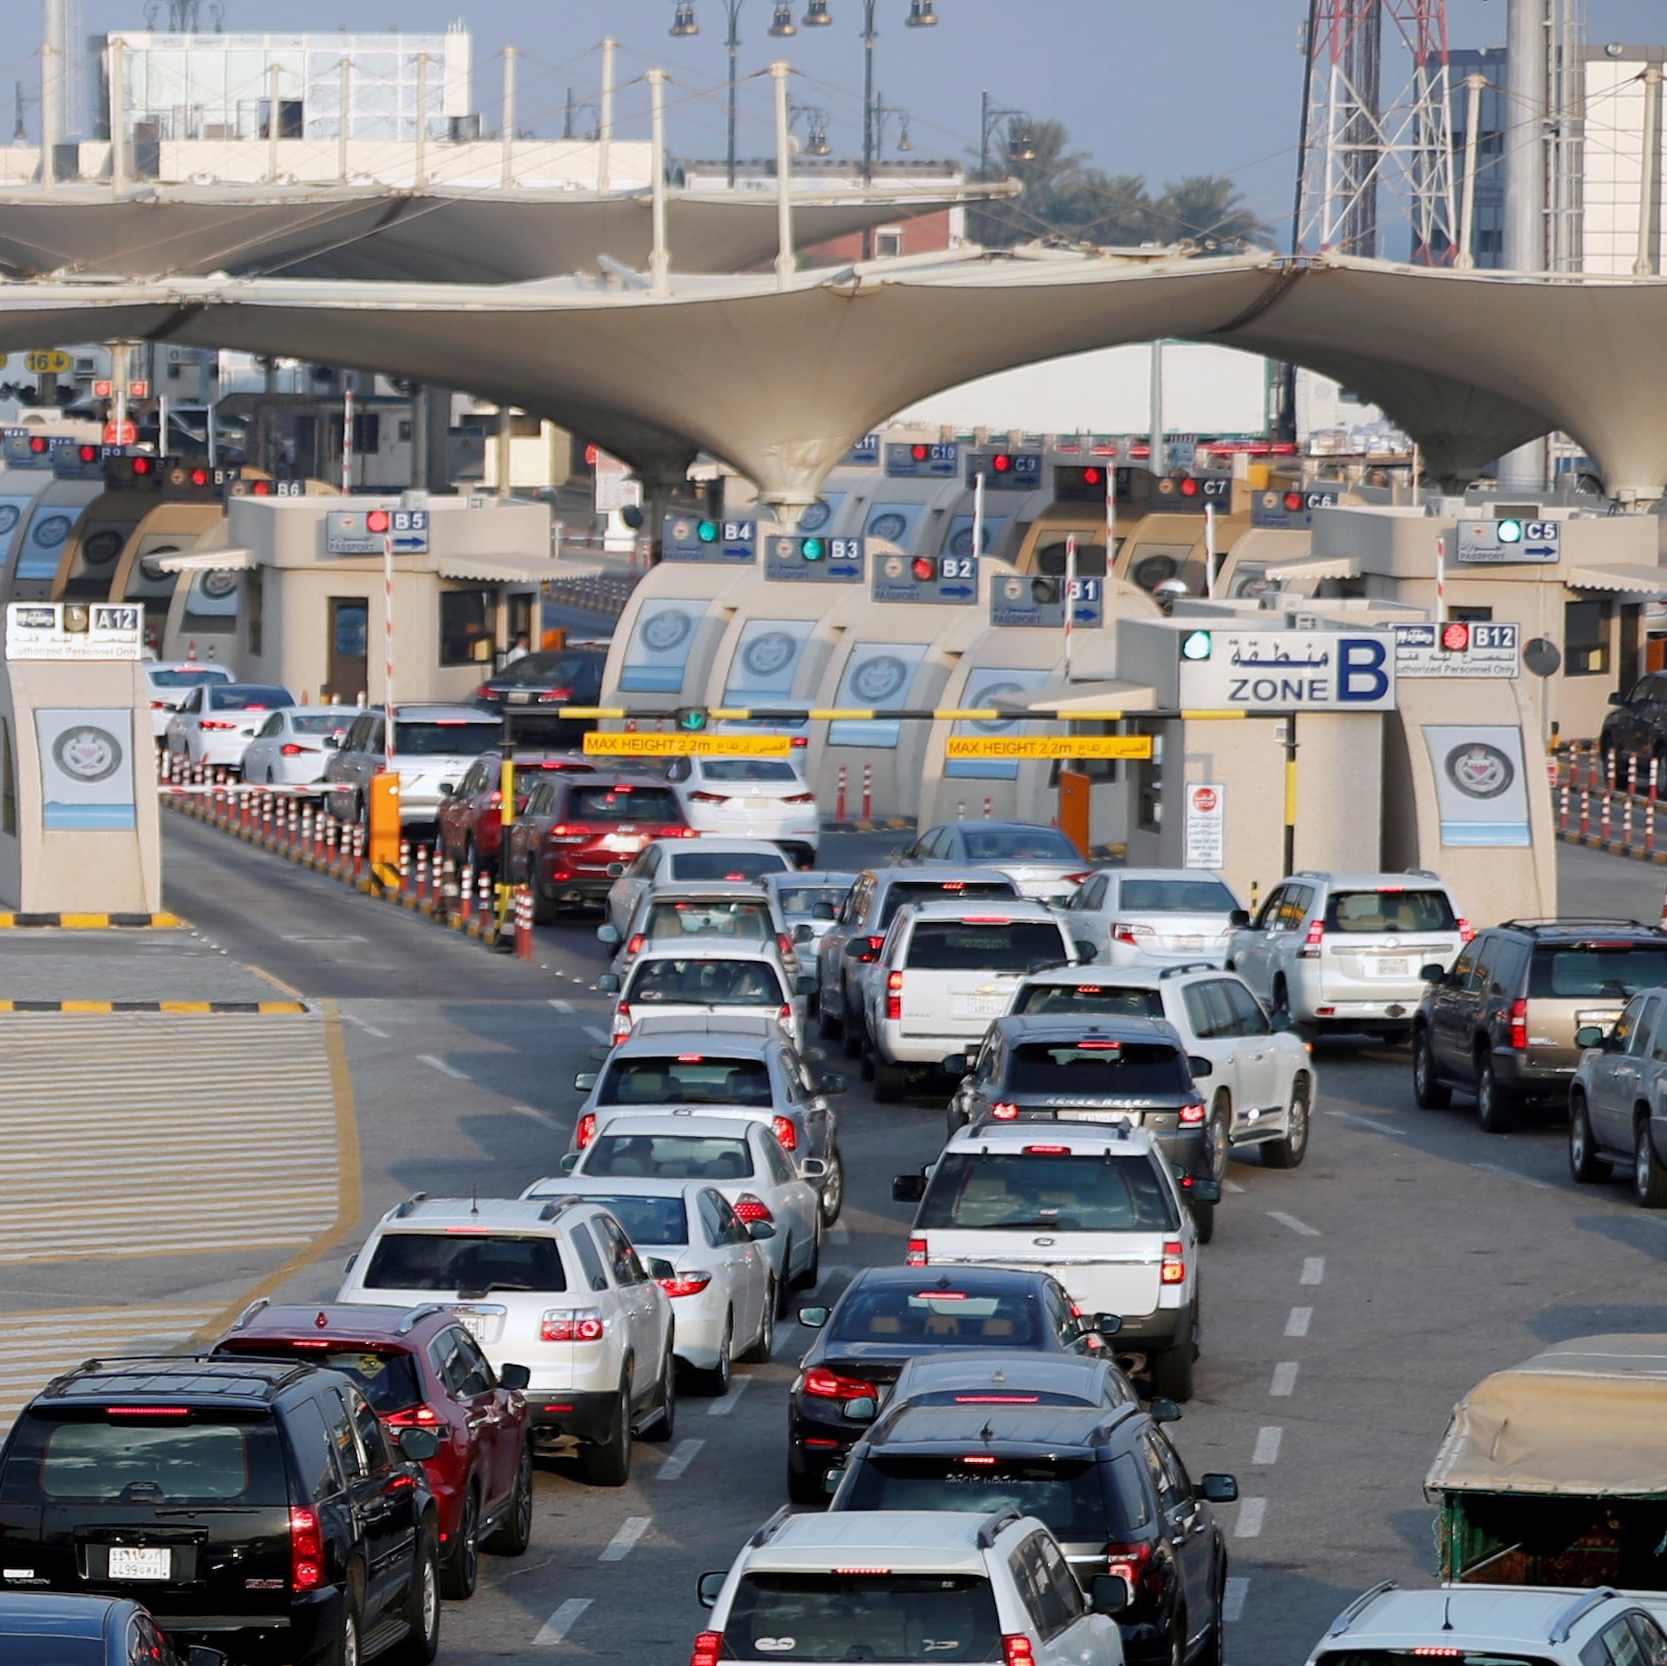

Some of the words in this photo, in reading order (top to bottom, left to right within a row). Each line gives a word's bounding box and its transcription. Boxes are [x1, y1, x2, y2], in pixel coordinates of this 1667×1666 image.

[28, 352, 49, 370] 16
[1015, 457, 1036, 471] C9
[277, 482, 299, 497] B6
[1203, 481, 1226, 496] C7
[394, 513, 424, 530] B5
[724, 523, 751, 541] B4
[1526, 523, 1556, 540] C5
[831, 541, 859, 559] B3
[942, 560, 972, 578] B2
[1069, 580, 1097, 599] B1
[98, 609, 134, 629] A12
[1475, 627, 1515, 646] B12
[16, 647, 62, 656] uthorized
[1226, 637, 1330, 669] منطقة
[1227, 678, 1330, 702] ZONE
[1336, 638, 1390, 703] B
[1398, 664, 1443, 675] uthorized
[1443, 664, 1494, 675] Personnel
[1494, 665, 1516, 677] Only
[586, 738, 618, 753] MAX
[621, 738, 675, 753] HEIGHT
[677, 738, 711, 753] 2.2m
[948, 741, 980, 756] MAX
[983, 741, 1037, 756] HEIGHT
[1039, 741, 1073, 756] 2.2m
[245, 1579, 284, 1589] GMC
